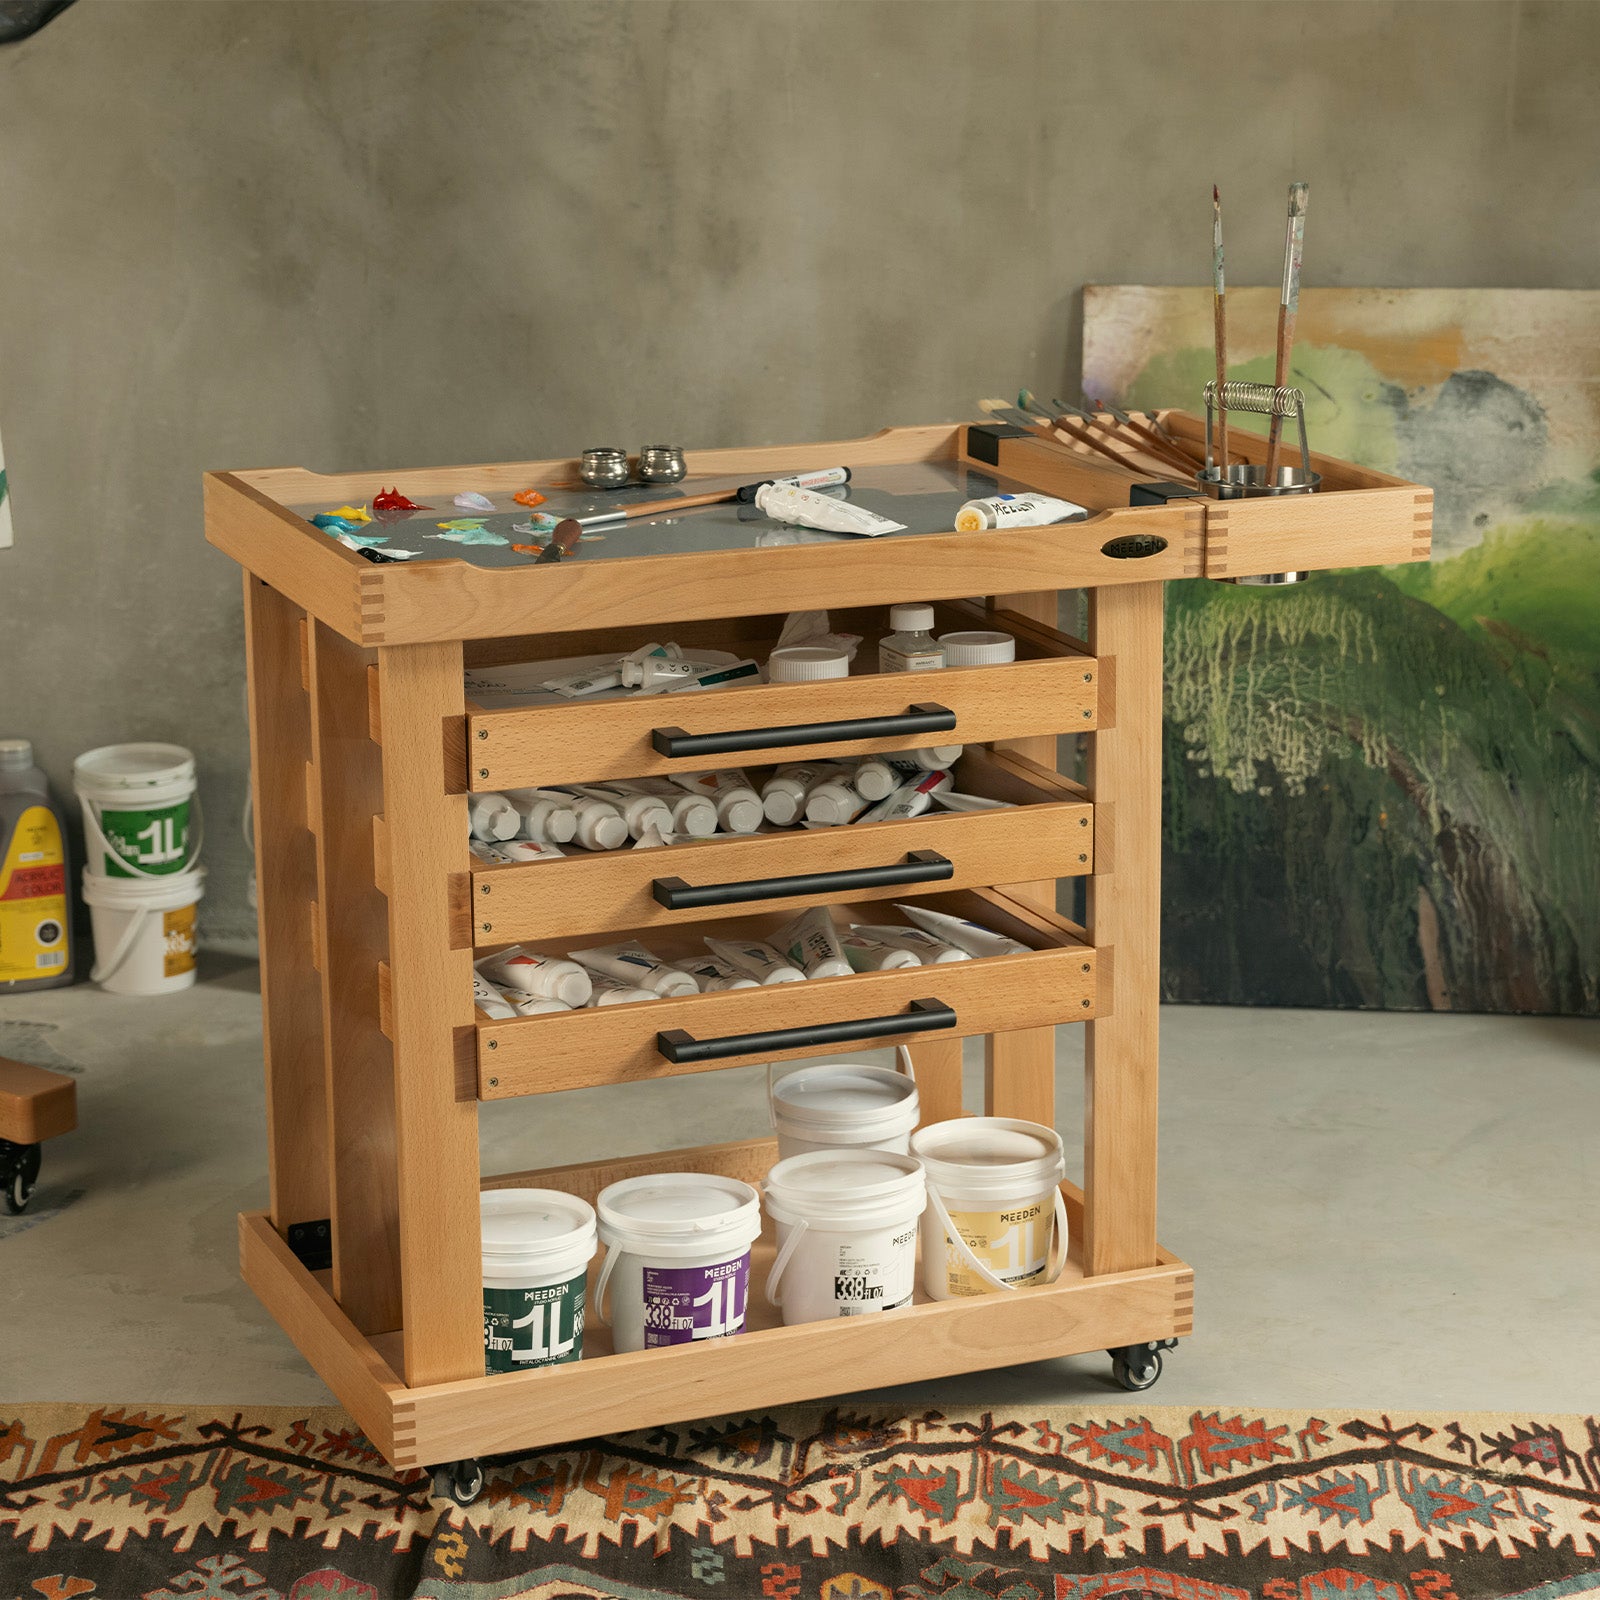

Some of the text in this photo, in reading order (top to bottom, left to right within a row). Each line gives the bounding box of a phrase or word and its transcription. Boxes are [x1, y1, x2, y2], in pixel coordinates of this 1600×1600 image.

[1110, 539, 1160, 554] MEEDEN
[137, 817, 184, 865] 1L
[22, 881, 62, 896] COLOR
[1000, 1206, 1041, 1223] MEEDEN
[990, 1222, 1046, 1279] 1L
[704, 1260, 742, 1279] MEEDEN
[524, 1284, 569, 1302] MEEDEN
[692, 1276, 744, 1339] 1L
[512, 1301, 574, 1361] 1L
